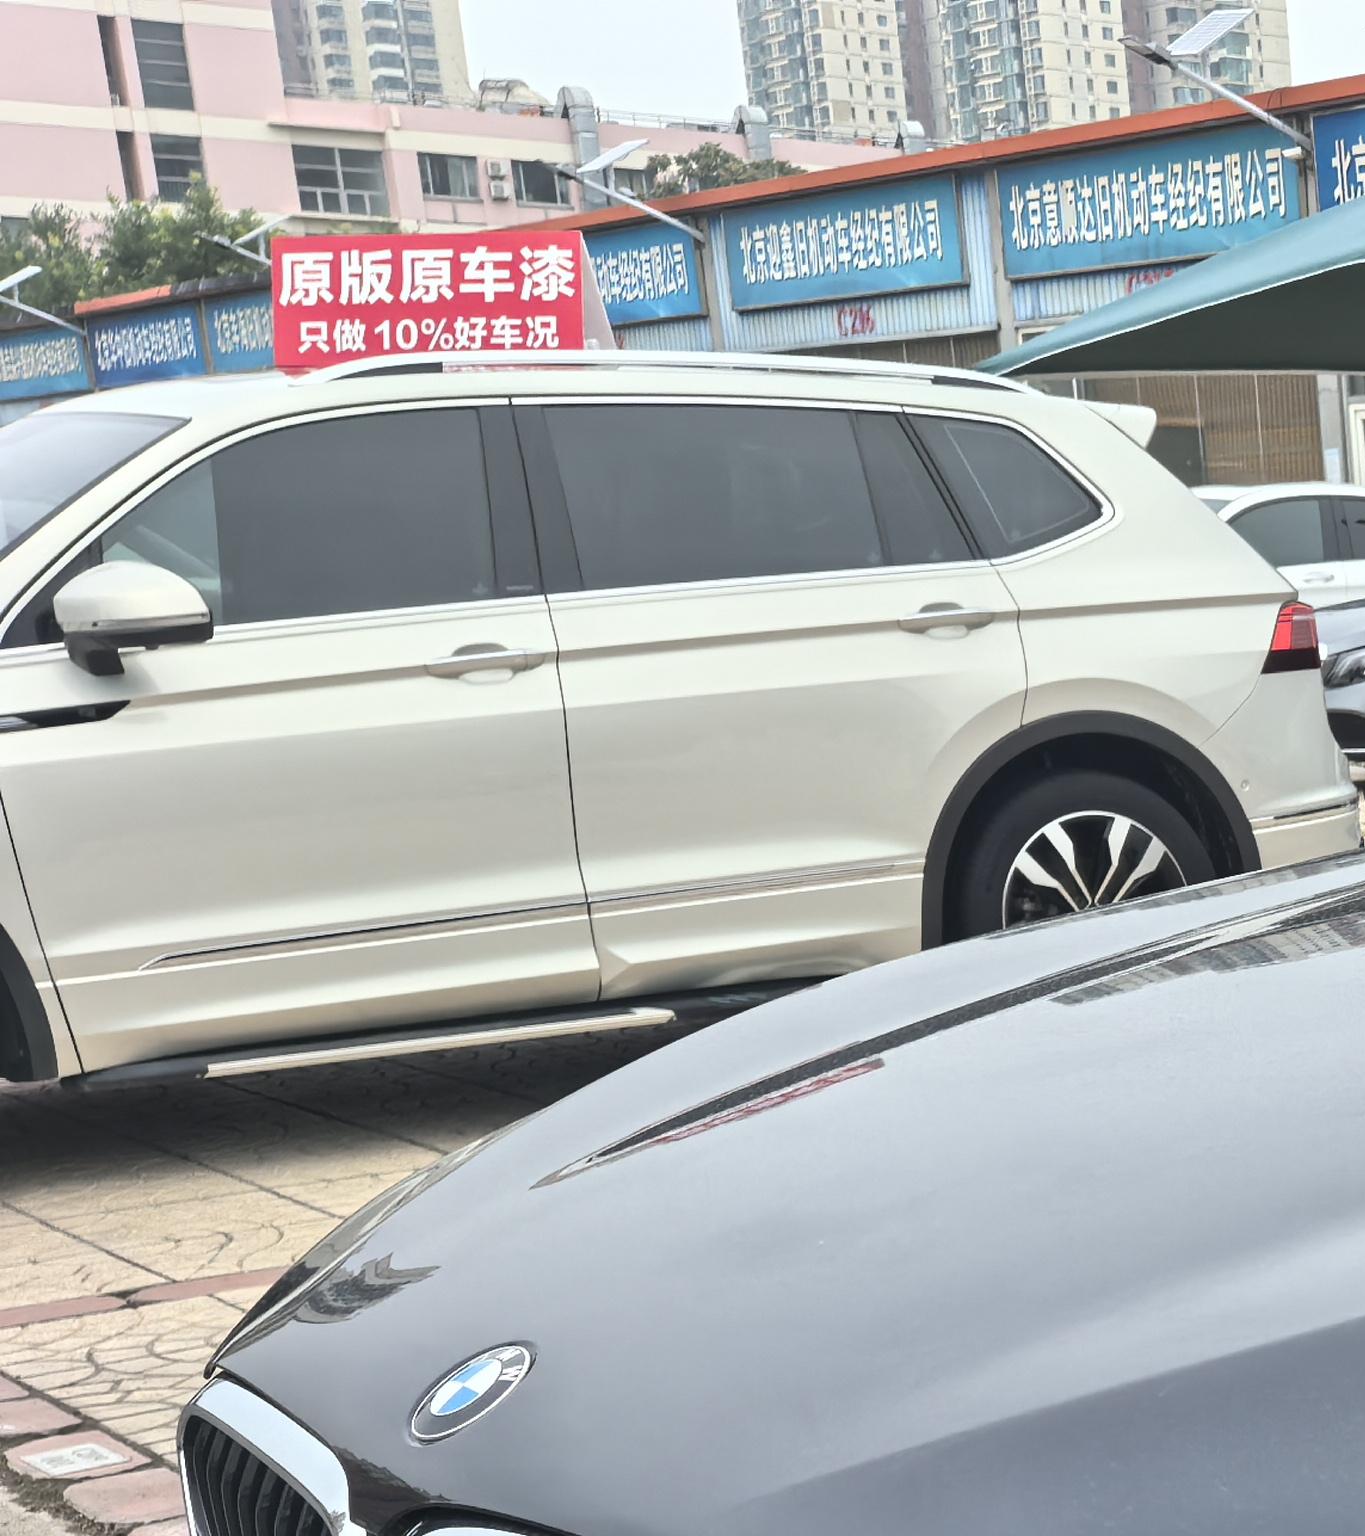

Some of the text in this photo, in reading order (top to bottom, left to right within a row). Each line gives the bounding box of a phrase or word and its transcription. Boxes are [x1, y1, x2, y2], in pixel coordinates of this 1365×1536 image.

[1009, 147, 1287, 250] 北京意顺达旧机动车经纪有限公司
[279, 244, 577, 307] 原版原车漆
